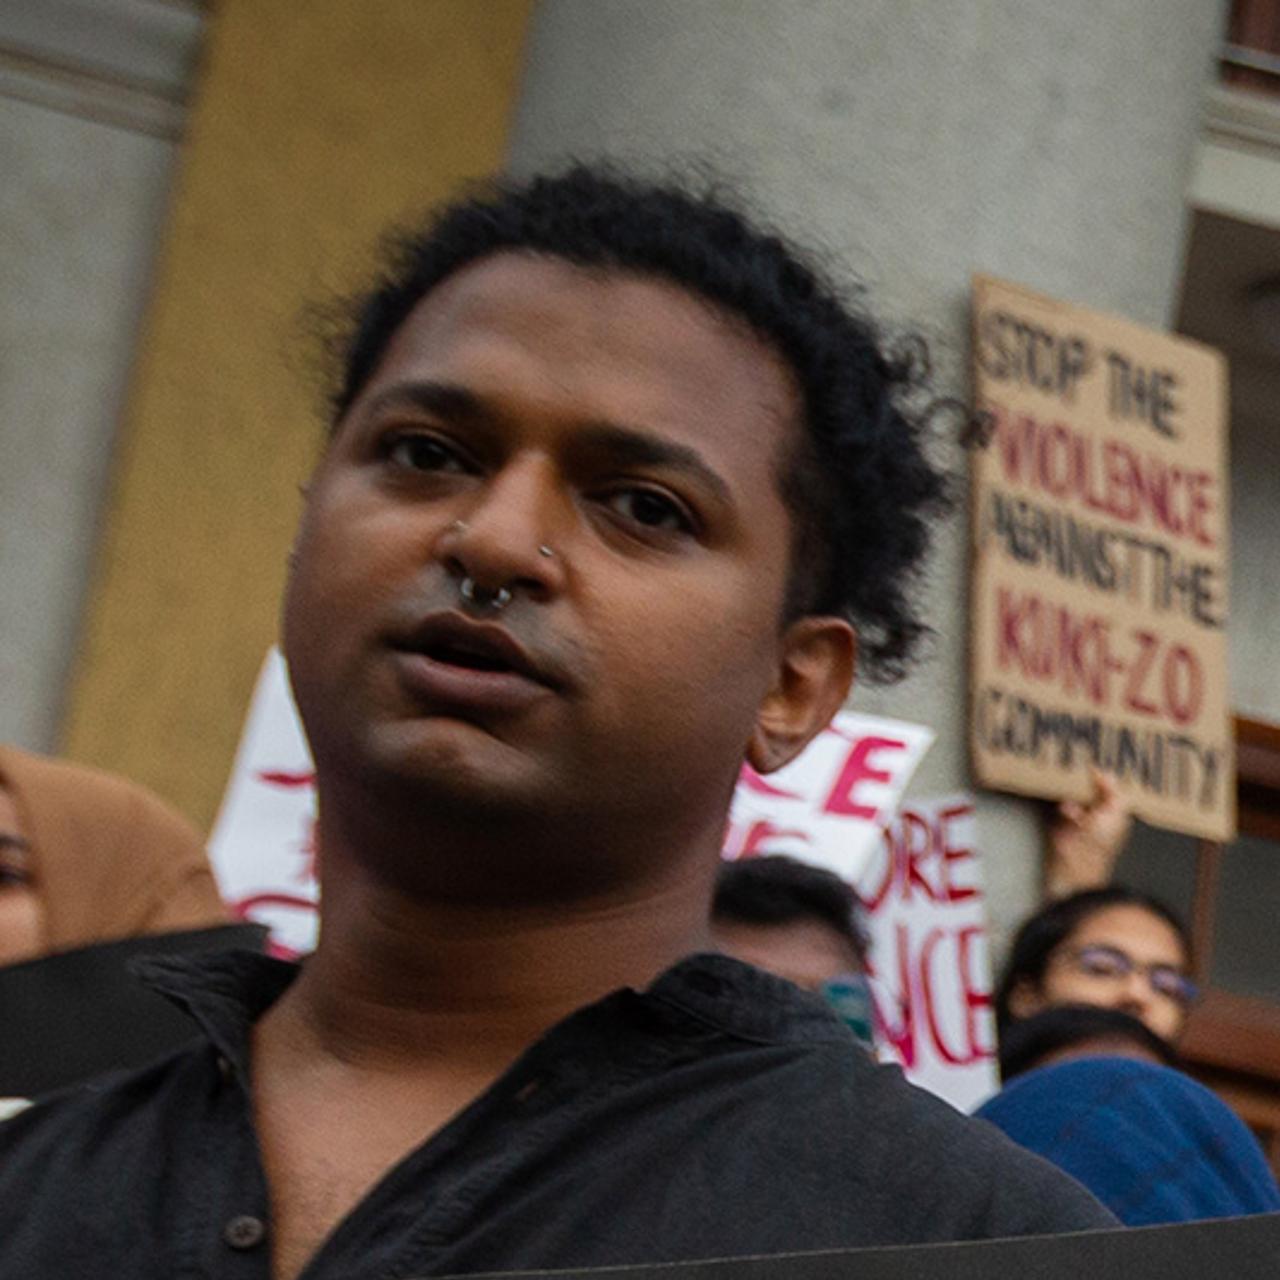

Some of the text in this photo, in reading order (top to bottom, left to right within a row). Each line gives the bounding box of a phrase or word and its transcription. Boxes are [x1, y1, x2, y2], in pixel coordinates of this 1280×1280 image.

[978, 311, 1180, 440] STOP THE
[990, 402, 1217, 548] VIOLENCE
[980, 488, 1224, 628] AGAINST THE
[976, 686, 1221, 813] COMMUNITY
